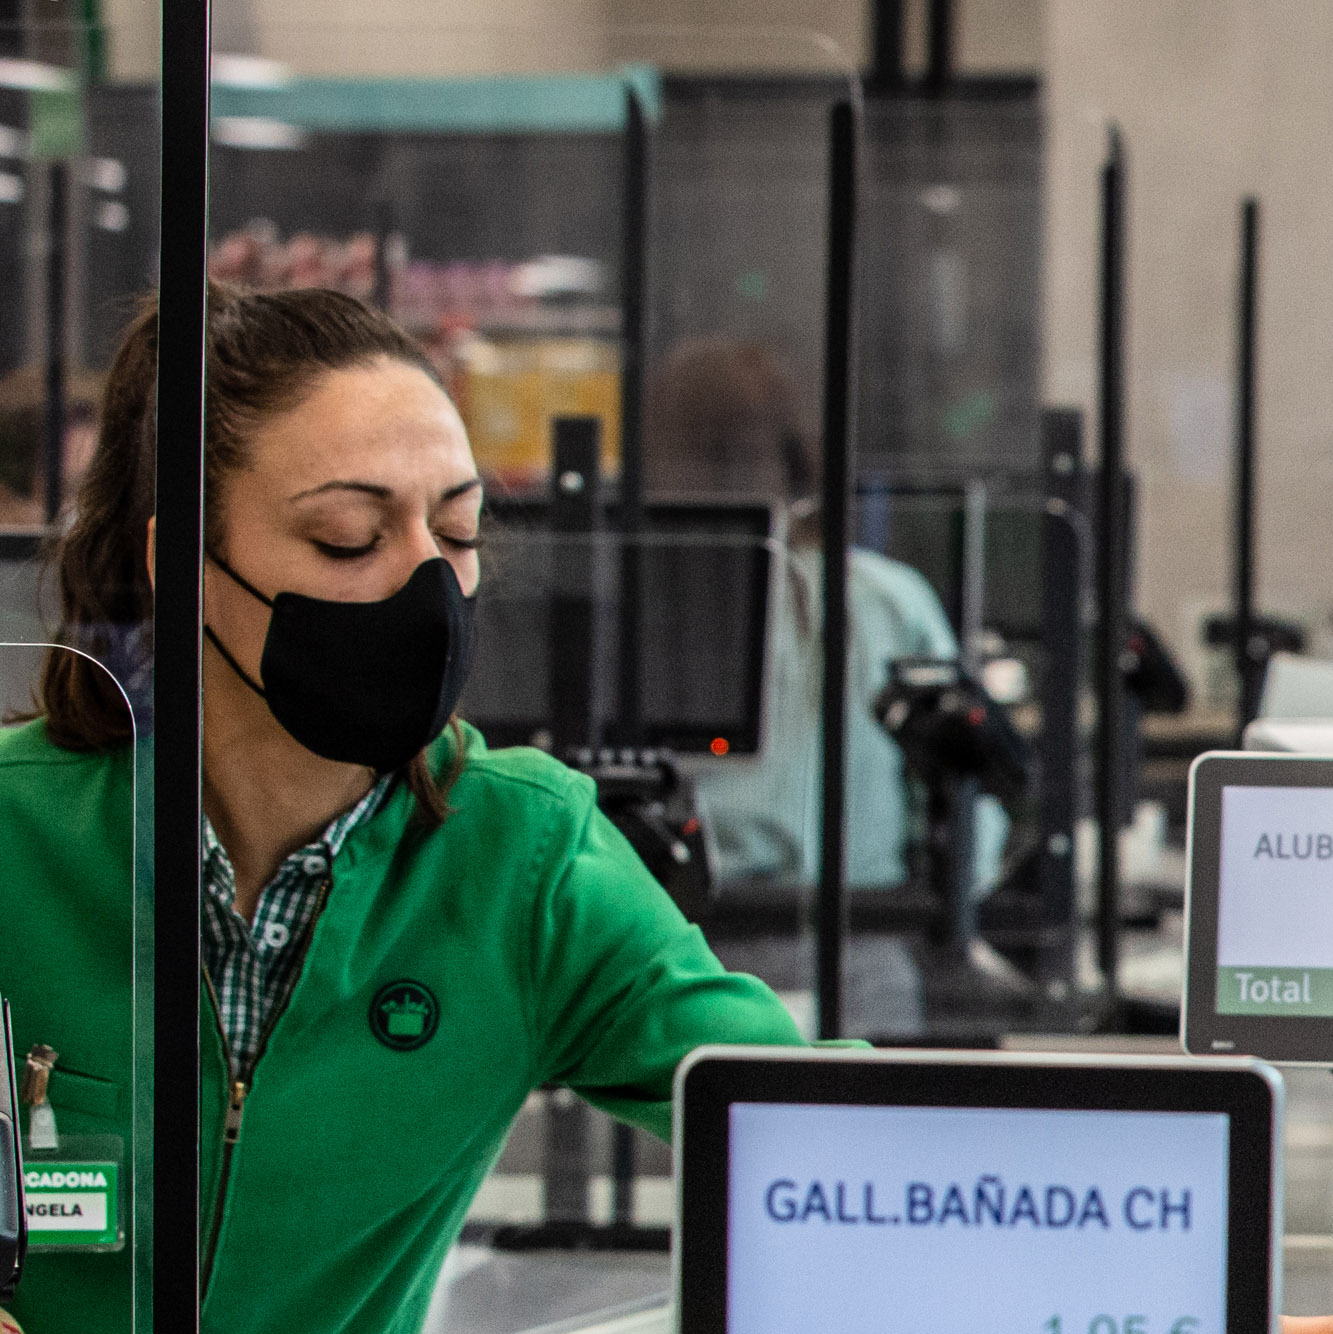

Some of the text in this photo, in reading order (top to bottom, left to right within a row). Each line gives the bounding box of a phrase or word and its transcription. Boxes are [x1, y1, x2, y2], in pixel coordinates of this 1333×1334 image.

[1235, 972, 1312, 1005] Total
[25, 1171, 107, 1188] CADONA
[26, 1203, 83, 1217] NGELA
[764, 1173, 1194, 1233] GALL.BAÑADA CH
